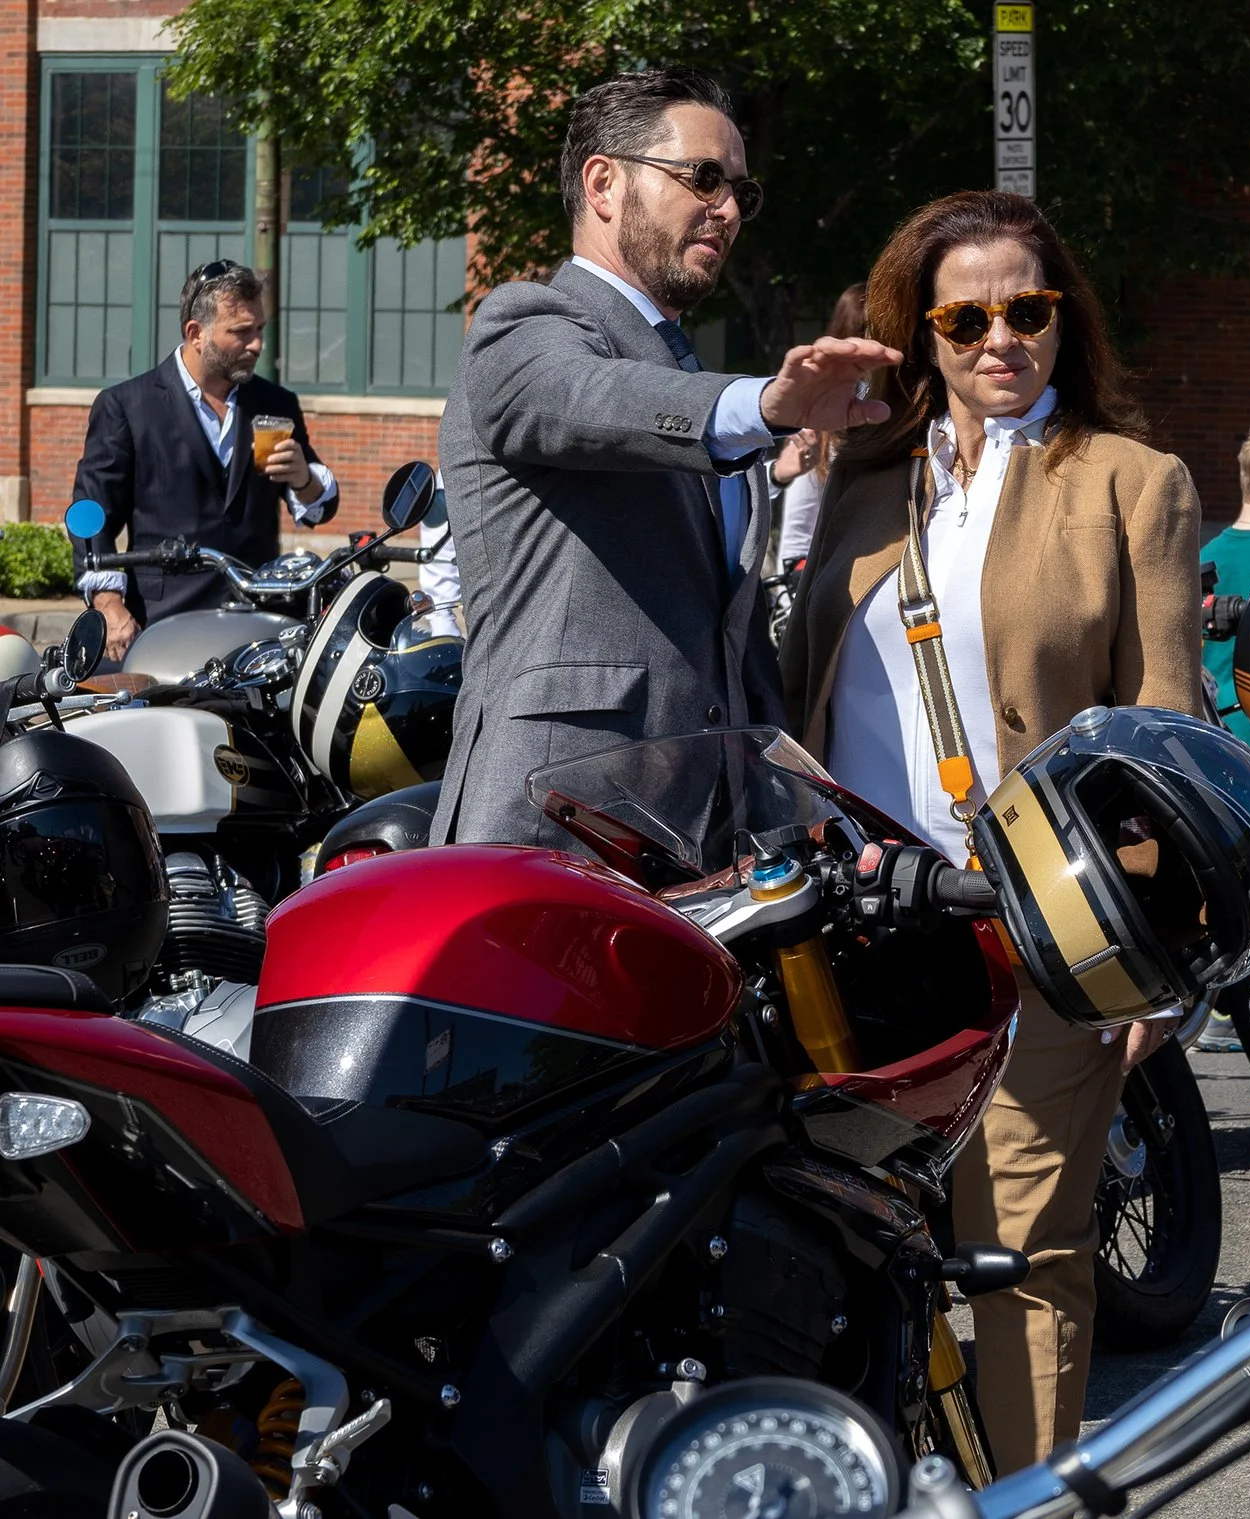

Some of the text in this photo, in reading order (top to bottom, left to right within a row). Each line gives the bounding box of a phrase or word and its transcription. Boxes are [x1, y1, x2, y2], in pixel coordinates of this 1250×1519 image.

[1000, 9, 1029, 25] PARK
[1000, 41, 1029, 57] SPEED
[1002, 66, 1026, 82] LIMIT
[1000, 90, 1031, 133] 30
[64, 948, 99, 965] BELL
